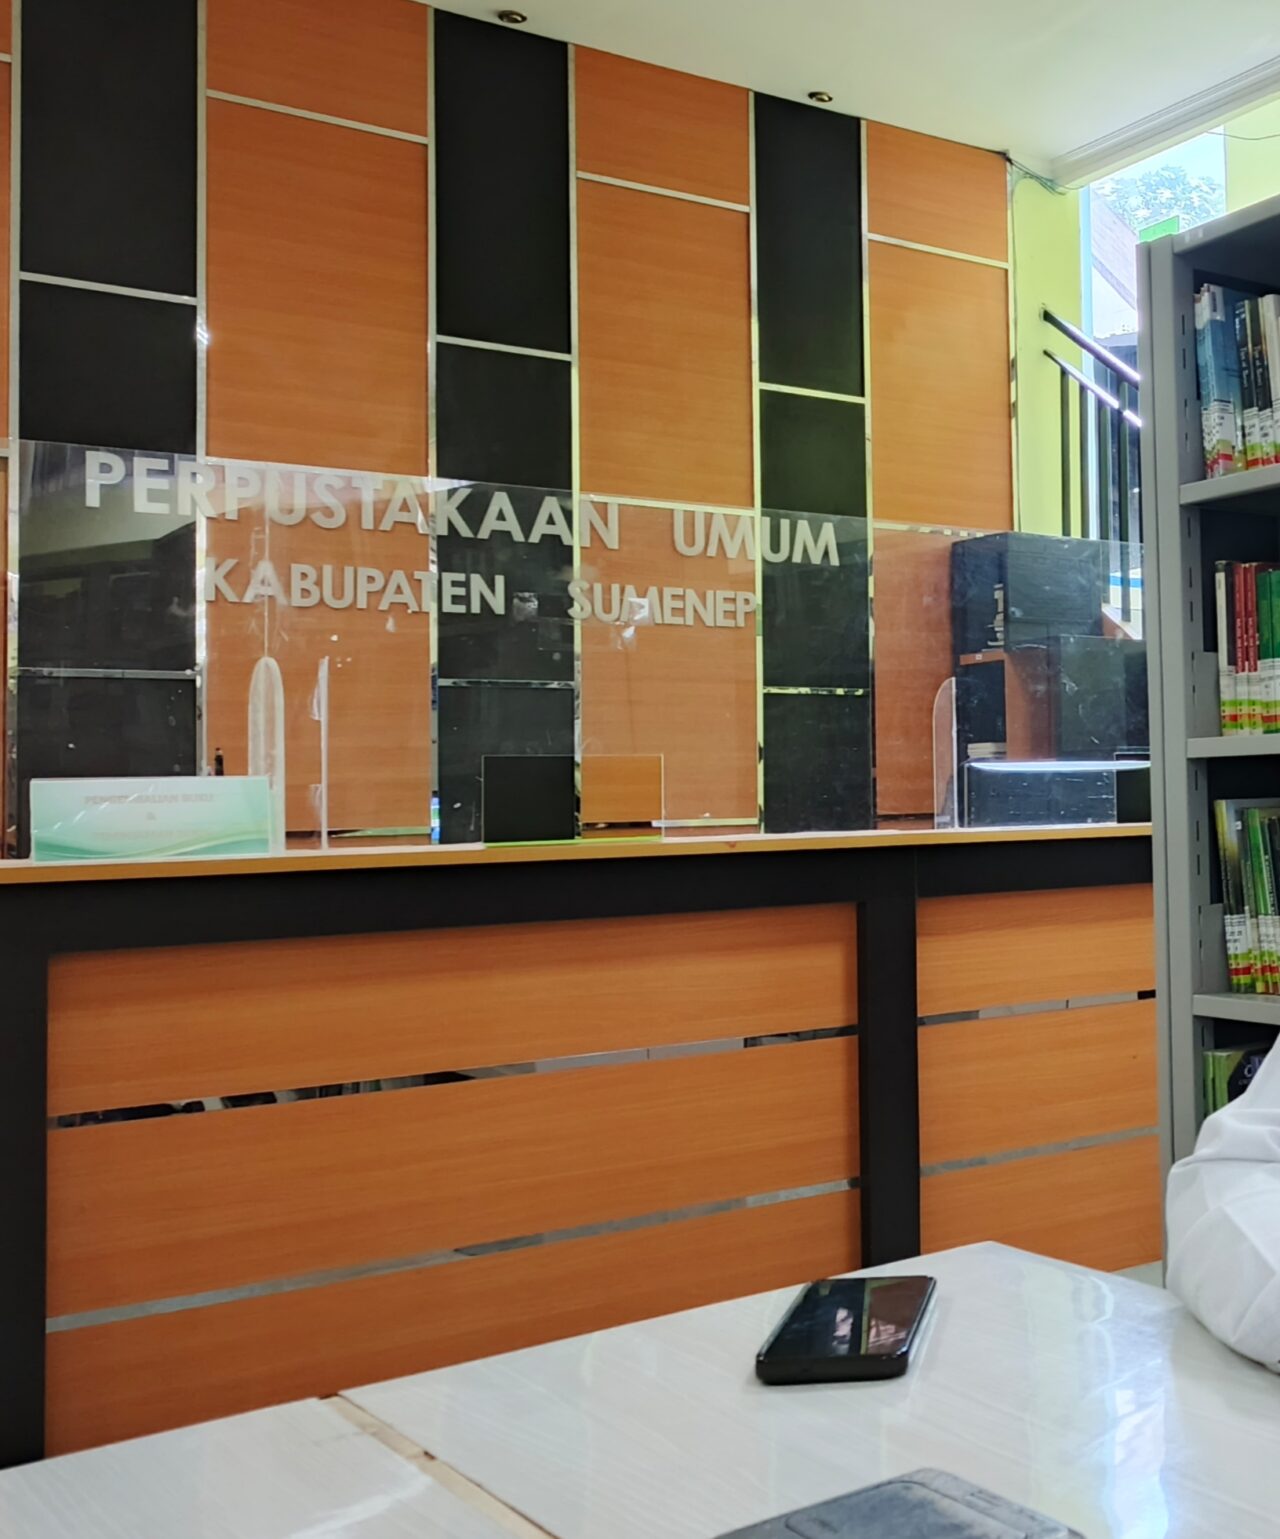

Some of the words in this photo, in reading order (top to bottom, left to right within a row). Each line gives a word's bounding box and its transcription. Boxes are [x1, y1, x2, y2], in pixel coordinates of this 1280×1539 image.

[83, 450, 620, 551] PERPUSTAKAAN
[672, 510, 840, 567] UMUM
[204, 557, 506, 616] KABUPATEN
[567, 579, 758, 629] SUMENEP
